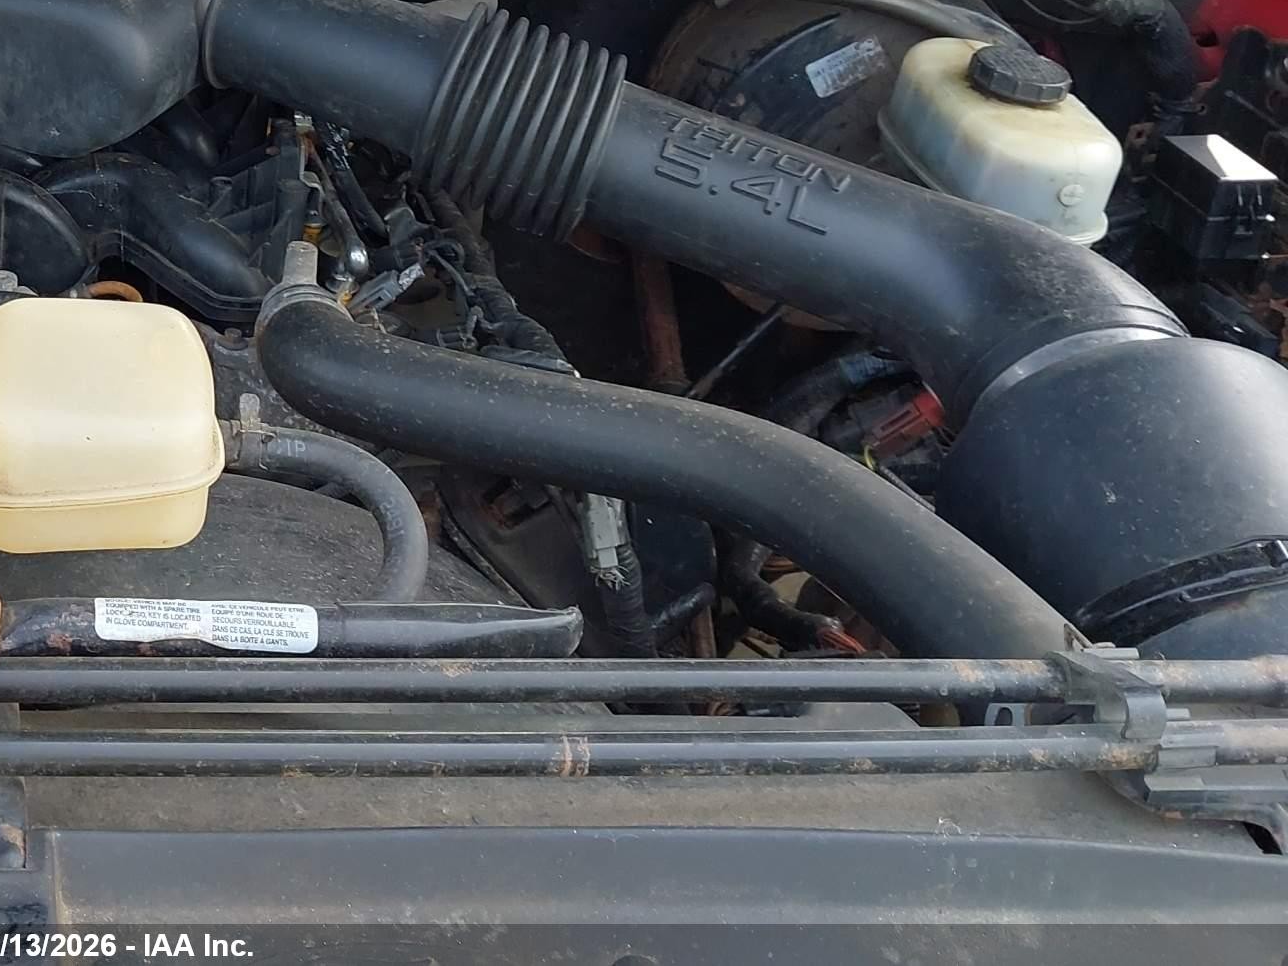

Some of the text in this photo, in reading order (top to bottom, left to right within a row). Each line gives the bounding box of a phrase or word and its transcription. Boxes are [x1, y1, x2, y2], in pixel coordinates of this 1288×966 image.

[665, 112, 852, 193] TRITON
[655, 137, 830, 236] 5.4L
[163, 605, 185, 613] SPARE
[113, 617, 137, 626] GLOVE
[148, 611, 162, 619] KEY
[170, 613, 202, 622] LOCATED
[211, 616, 243, 625] SECOURS
[211, 624, 229, 633] DANS
[229, 626, 239, 634] CE
[285, 630, 310, 639] TROUVE
[211, 634, 230, 642] DANS
[230, 635, 239, 643] LA
